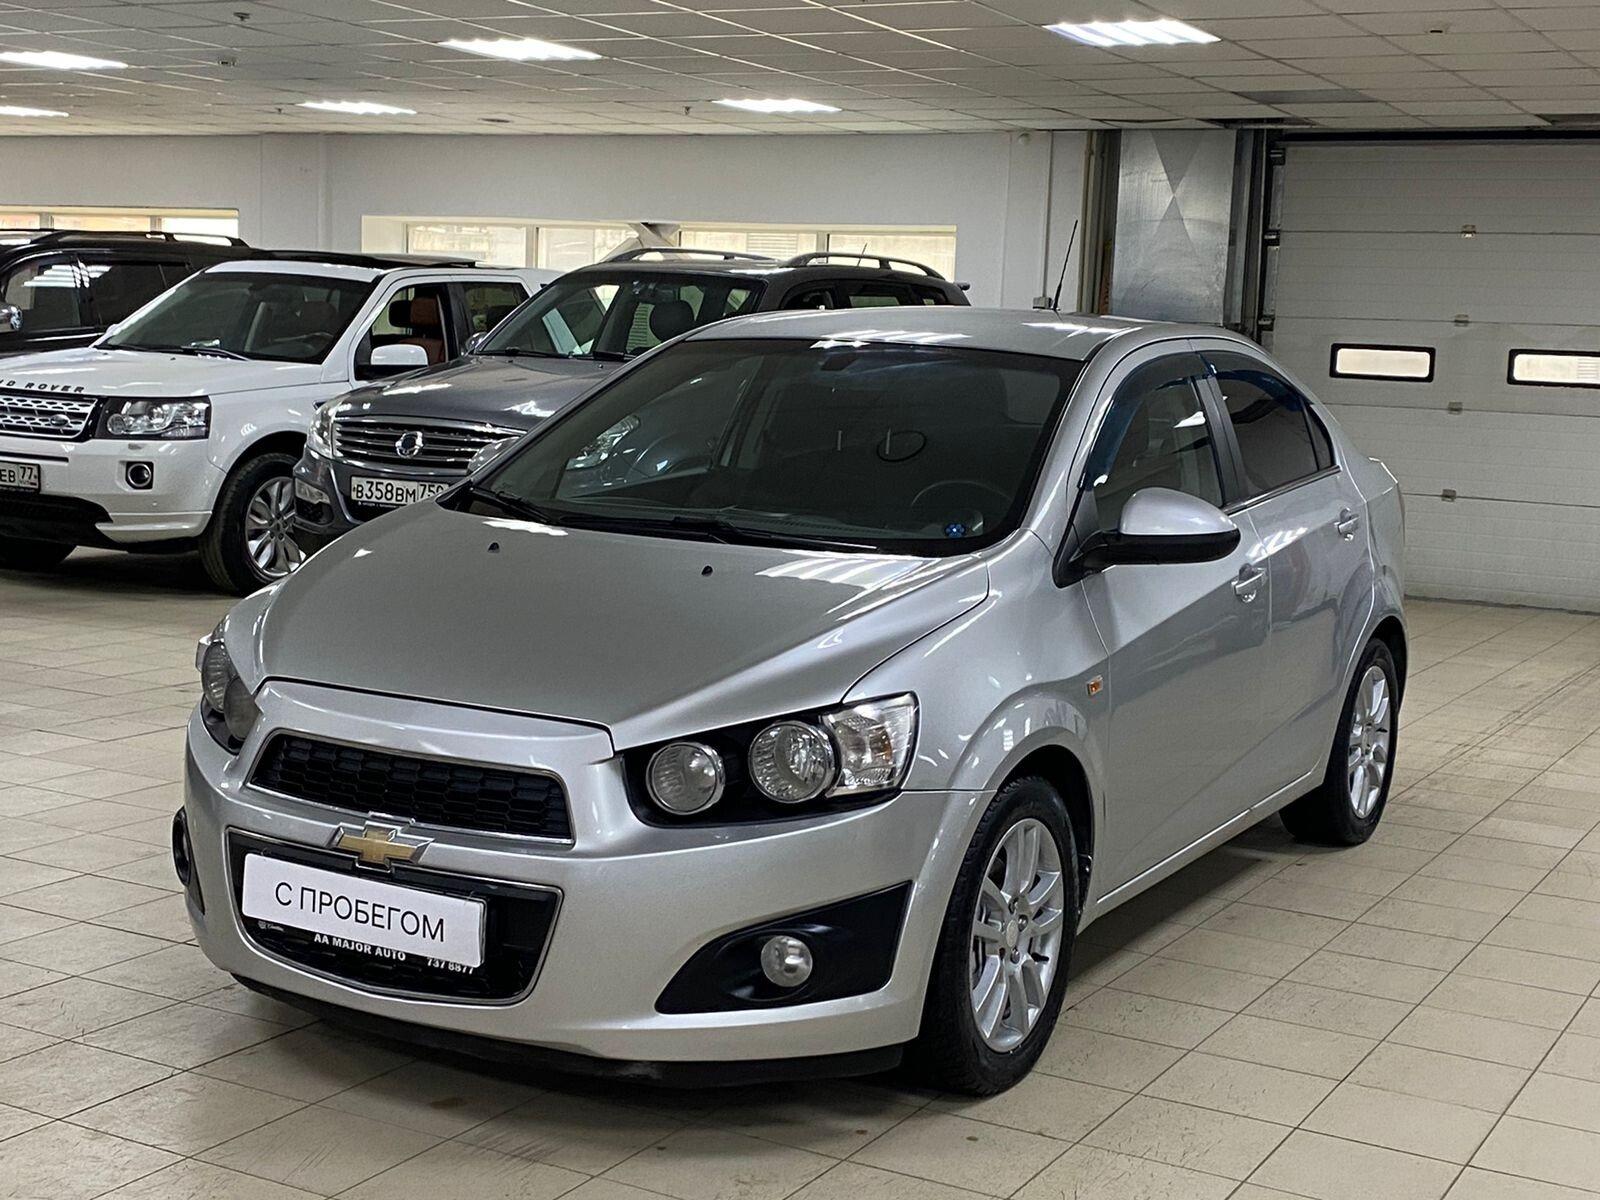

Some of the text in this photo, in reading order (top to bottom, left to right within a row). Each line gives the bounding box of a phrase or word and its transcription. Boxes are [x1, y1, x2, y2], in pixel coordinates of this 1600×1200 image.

[25, 382, 85, 393] ROVER
[20, 466, 33, 480] 77
[356, 481, 416, 502] В358ВМ
[275, 882, 444, 943] С ПРОБЕГОМ
[314, 933, 406, 961] AA MAJOR AUTO
